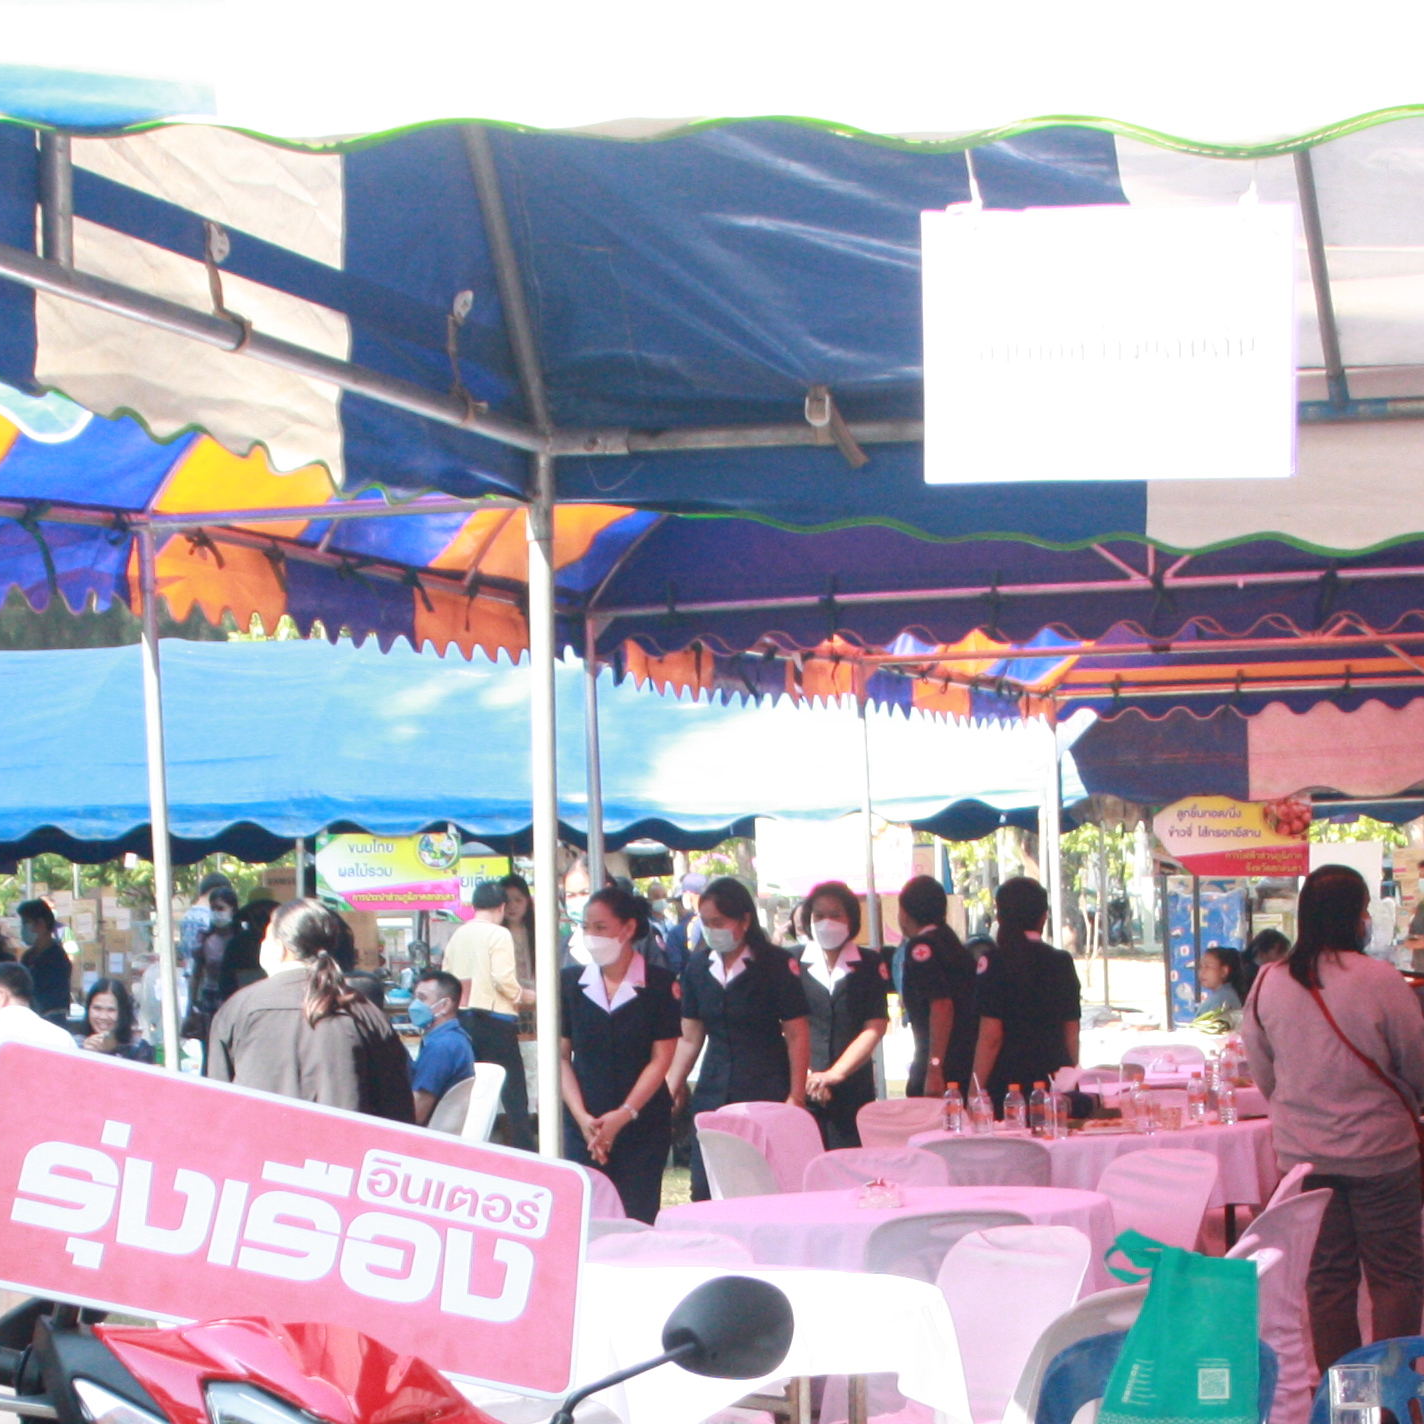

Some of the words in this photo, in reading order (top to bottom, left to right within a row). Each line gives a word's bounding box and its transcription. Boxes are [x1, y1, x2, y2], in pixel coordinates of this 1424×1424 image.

[337, 862, 394, 878] ผลไม้รวม
[347, 839, 395, 855] ขนมไทย
[365, 1156, 547, 1232] อินเตอร์
[10, 1119, 535, 1323] รุ่งเรือง
